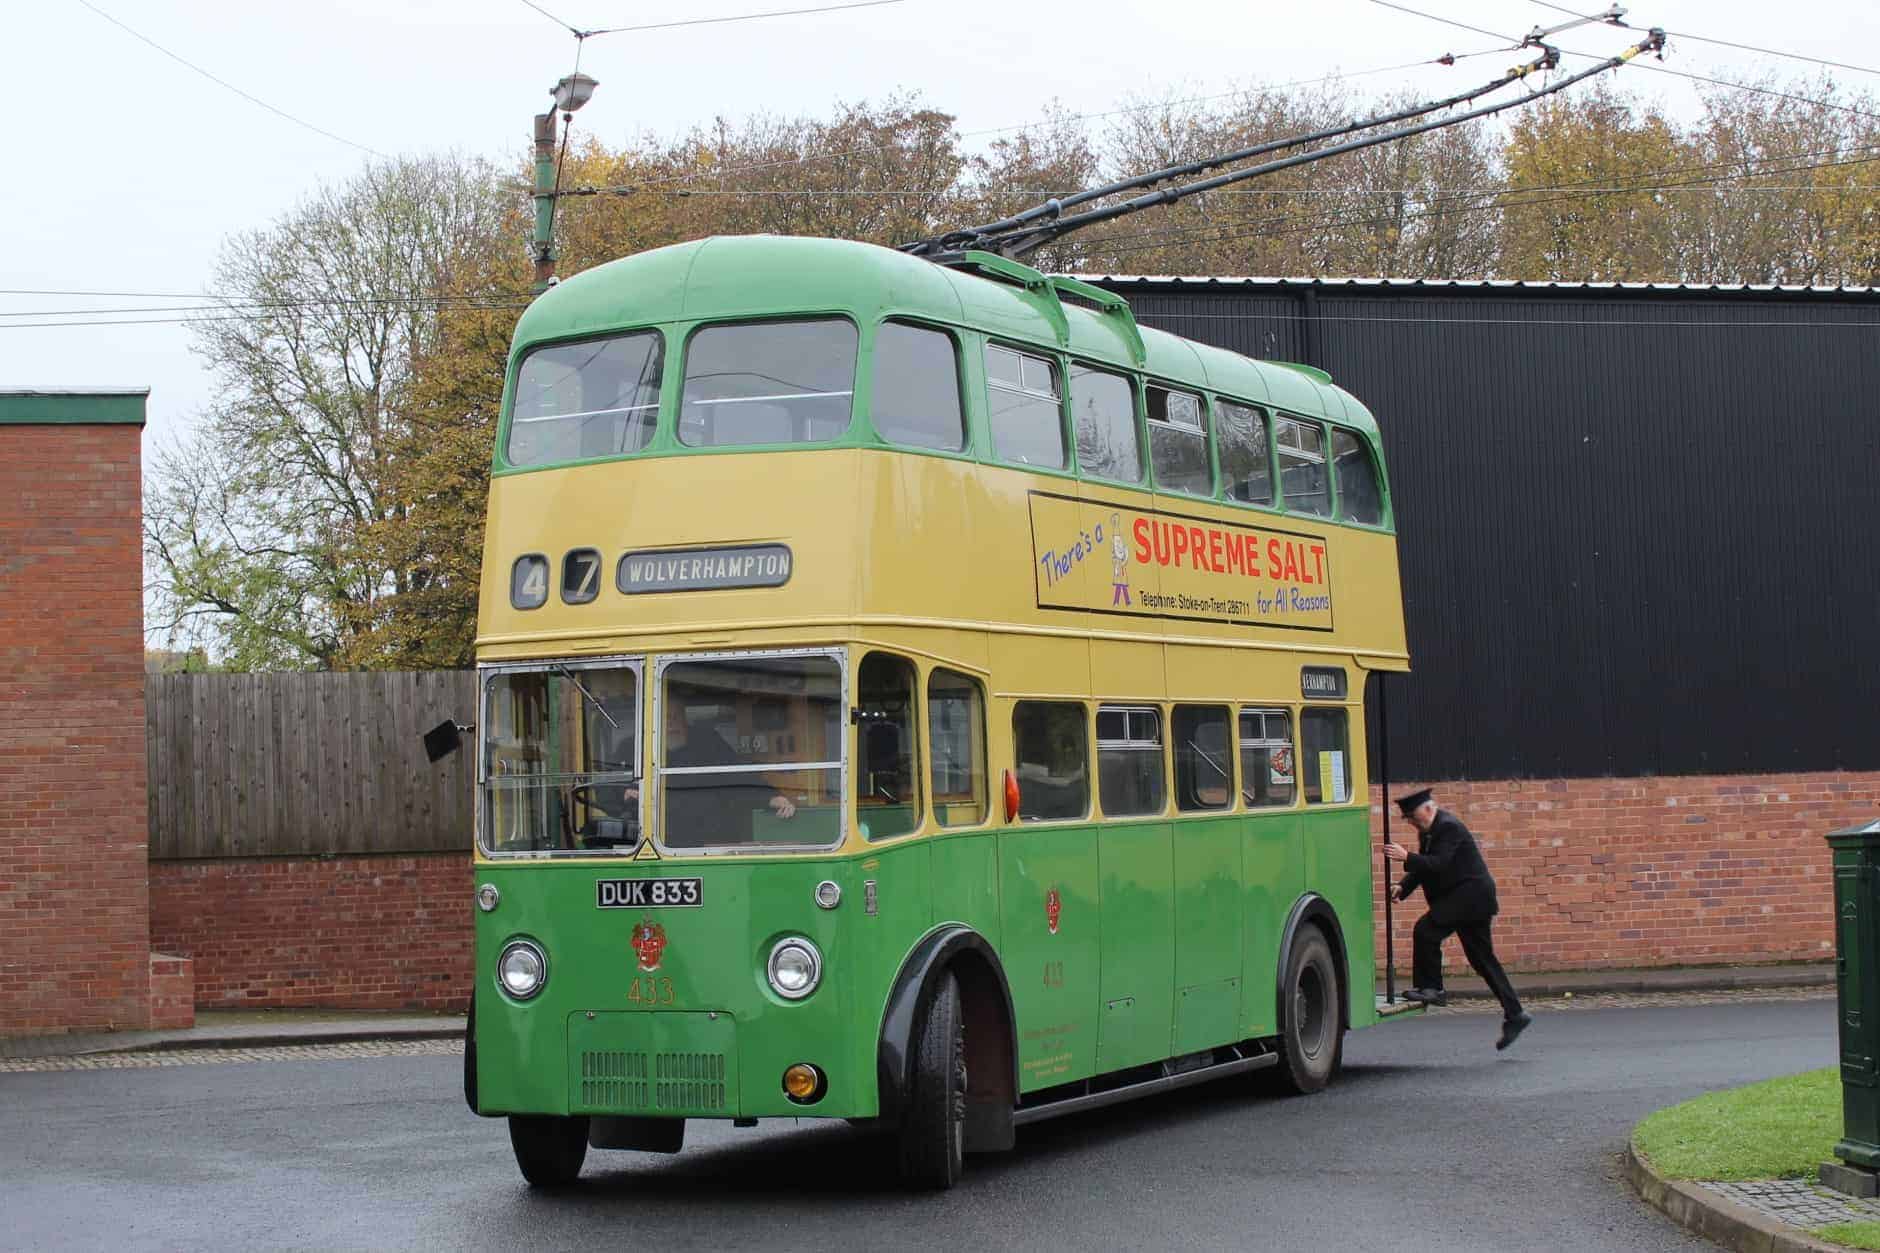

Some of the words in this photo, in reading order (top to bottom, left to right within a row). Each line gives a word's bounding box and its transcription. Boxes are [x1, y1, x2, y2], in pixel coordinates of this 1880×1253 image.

[1041, 531, 1092, 588] There's
[1095, 524, 1103, 543] a
[1133, 518, 1260, 577] SUPREME
[1267, 539, 1324, 584] SALT
[522, 563, 545, 600] 4
[575, 558, 599, 598] 7
[629, 554, 790, 583] WOLVERHAMPTON
[1257, 589, 1271, 613] for
[1275, 587, 1287, 612] All
[1290, 587, 1329, 611] Reasons
[602, 881, 645, 905] DUK
[650, 880, 698, 904] 833
[628, 976, 676, 1005] 433
